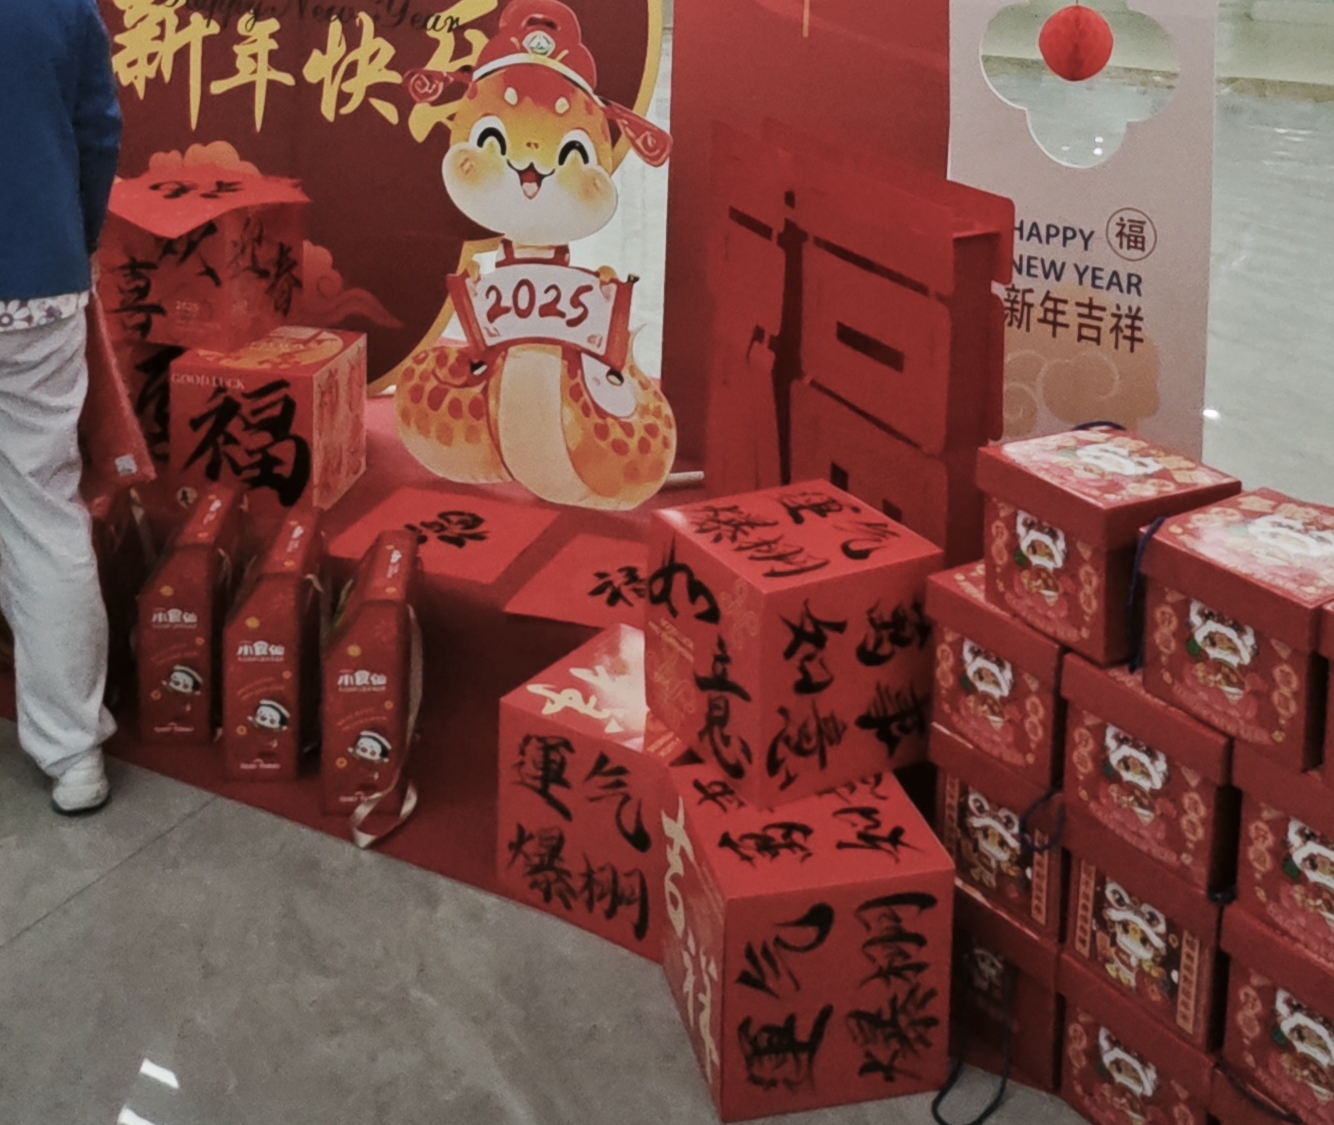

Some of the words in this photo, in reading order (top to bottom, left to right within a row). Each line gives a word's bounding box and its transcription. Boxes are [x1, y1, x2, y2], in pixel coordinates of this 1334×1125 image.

[1014, 218, 1095, 252] HAPPY
[1114, 215, 1147, 253] 福
[1013, 253, 1067, 283] NEW
[1073, 262, 1143, 298] YEAR
[485, 277, 594, 328] 2025
[1003, 283, 1145, 354] 新年吉祥
[170, 372, 210, 388] GOOD
[182, 377, 311, 508] 福
